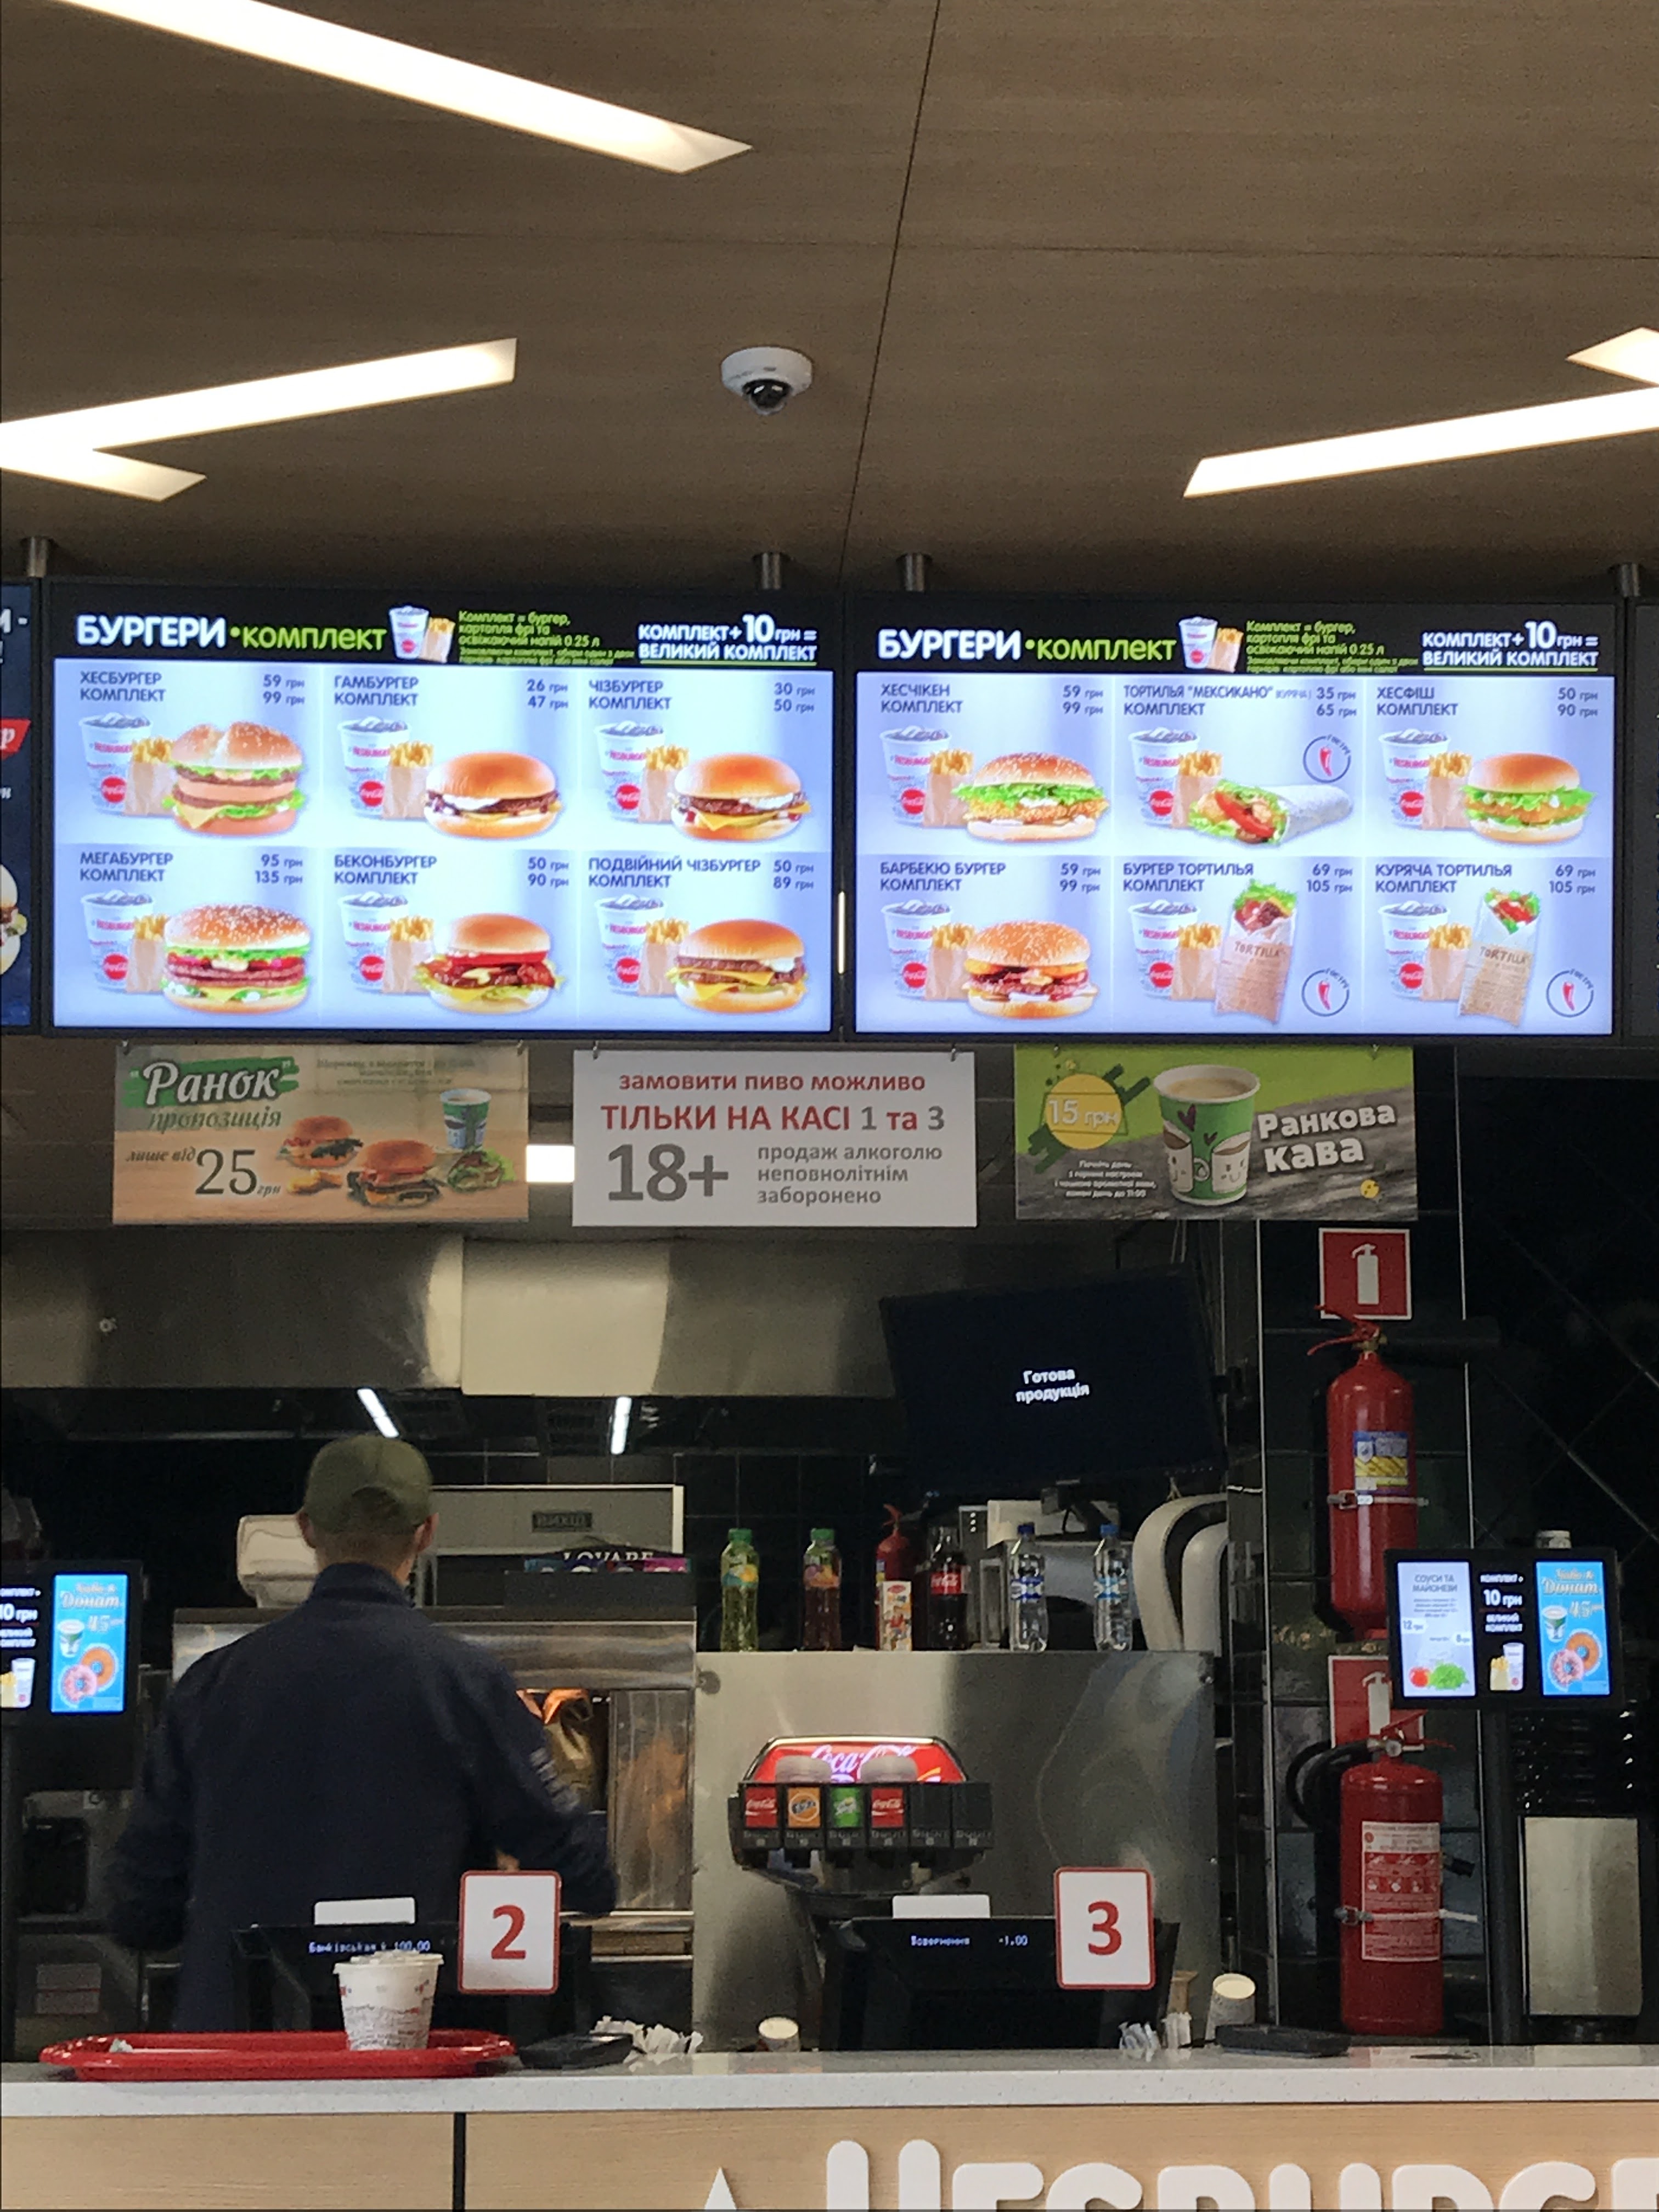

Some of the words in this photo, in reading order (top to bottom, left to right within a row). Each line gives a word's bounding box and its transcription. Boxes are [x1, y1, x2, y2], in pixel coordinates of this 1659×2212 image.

[459, 611, 515, 623] Комплект
[77, 614, 226, 648] БУРГЕРИ
[242, 626, 387, 650] комплект
[1246, 620, 1301, 631] Комплект
[639, 641, 720, 659] ВЕЛИКИЙ
[723, 644, 817, 661] КОМПЛЕКТ
[878, 628, 1022, 659] БУРГЕРИ
[1037, 639, 1177, 661] комплект
[1423, 648, 1502, 665] ВЕЛИКИЙ
[1505, 651, 1599, 666] КОМПЛЕКТ
[80, 671, 162, 685] ХЕСБУРГЕР
[263, 674, 281, 687] 59
[285, 679, 304, 689] грн
[334, 675, 419, 690] ГАМБУРГЕР
[527, 679, 545, 692] 26
[549, 684, 568, 693] грн
[588, 680, 663, 693] ЧІЗБУРГЕР
[774, 682, 792, 696] 30
[797, 687, 815, 697] грн
[881, 684, 950, 697] ХЕСЧІКЕН
[1063, 685, 1081, 698] 59
[1085, 690, 1103, 699] грн
[1124, 685, 1184, 698] ТОРТИЛЬЯ
[1376, 687, 1435, 699] ХЕСФІШ
[80, 688, 166, 702] КОМПЛЕКТ
[263, 691, 281, 704] 99
[285, 696, 304, 706] грн
[334, 692, 419, 706] КОМПЛЕКТ
[1316, 687, 1334, 700] 35
[1338, 692, 1356, 701] грн
[1558, 687, 1576, 700] 50
[1579, 692, 1598, 702] грн
[527, 695, 546, 708] 47
[549, 700, 568, 710] грн
[589, 697, 672, 710] КОМПЛЕКТ
[774, 699, 792, 712] 50
[795, 704, 815, 714] грн
[881, 700, 963, 713] КОМПЛЕКТ
[1063, 702, 1081, 714] 99
[1085, 707, 1103, 716] грн
[1124, 703, 1205, 715] КОМПЛЕКТ
[1376, 703, 1458, 716] КОМПЛЕКТ
[1316, 704, 1334, 716] 65
[1338, 709, 1357, 718] грн
[1558, 703, 1576, 716] 90
[1579, 709, 1598, 718] грн
[80, 852, 173, 865] МЕГАБУРГЕР
[261, 854, 280, 867] 95
[284, 859, 303, 868] грн
[334, 855, 437, 868] БЕКОНБУРГЕР
[528, 857, 546, 870] 50
[550, 862, 569, 871] грн
[588, 855, 682, 871] ПОДВІЙНИЙ
[687, 860, 761, 873] ЧІЗБУРГЕР
[773, 860, 792, 873] 50
[795, 865, 814, 874] грн
[881, 861, 950, 875] БАРБЕКЮ
[955, 862, 1006, 876] БУРГЕР
[1060, 863, 1079, 876] 59
[1082, 868, 1101, 878] грн
[1123, 863, 1174, 876] БУРГЕР
[1179, 863, 1254, 876] ТОРТИЛЬЯ
[1312, 864, 1330, 877] 69
[1334, 869, 1353, 878] грн
[1375, 864, 1432, 877] КУРЯЧА
[1437, 865, 1512, 877] ТОРТИЛЬЯ
[1555, 865, 1573, 878] 69
[1577, 870, 1596, 879] грн
[80, 869, 166, 882] КОМПЛЕКТ
[255, 871, 280, 884] 135
[284, 876, 303, 885] грн
[334, 872, 419, 885] КОМПЛЕКТ
[528, 873, 546, 887] 90
[550, 879, 569, 888] грн
[588, 874, 672, 888] КОМПЛЕКТ
[773, 876, 792, 889] 89
[795, 881, 814, 891] грн
[881, 878, 962, 891] КОМПЛЕКТ
[1059, 879, 1077, 892] 99
[1081, 884, 1100, 894] грн
[1123, 879, 1205, 892] КОМПЛЕКТ
[1306, 880, 1330, 893] 105
[1334, 884, 1353, 894] грн
[1375, 881, 1457, 893] КОМПЛЕКТ
[1549, 881, 1573, 893] 105
[1577, 885, 1596, 895] грн
[619, 1075, 737, 1091] замовити
[744, 1075, 804, 1091] пиво
[810, 1075, 926, 1091] можливо
[148, 1105, 281, 1134] пропозиція
[601, 1105, 715, 1130] ТІЛЬКИ
[728, 1105, 771, 1130] НА
[782, 1106, 850, 1130] КАСІ
[861, 1107, 877, 1130] 1
[887, 1111, 917, 1130] та
[928, 1106, 944, 1130] 3
[1048, 1099, 1080, 1124] 15
[1084, 1112, 1118, 1127] грн
[1258, 1104, 1396, 1139] Ранкова
[758, 1147, 838, 1164] продаж
[844, 1147, 943, 1160] алкоголю
[195, 1149, 257, 1195] 25
[257, 1186, 281, 1198] грн
[608, 1143, 729, 1201] 18+
[758, 1165, 908, 1181] неповнолітнім
[757, 1186, 882, 1206] заборонено
[1023, 1369, 1075, 1384] Готова
[1015, 1383, 1090, 1404] продукція
[1483, 1589, 1501, 1606] 10
[1502, 1595, 1522, 1608] грн
[16, 1610, 38, 1623] грн
[491, 1905, 526, 1959] 2
[1088, 1900, 1122, 1955] 3
